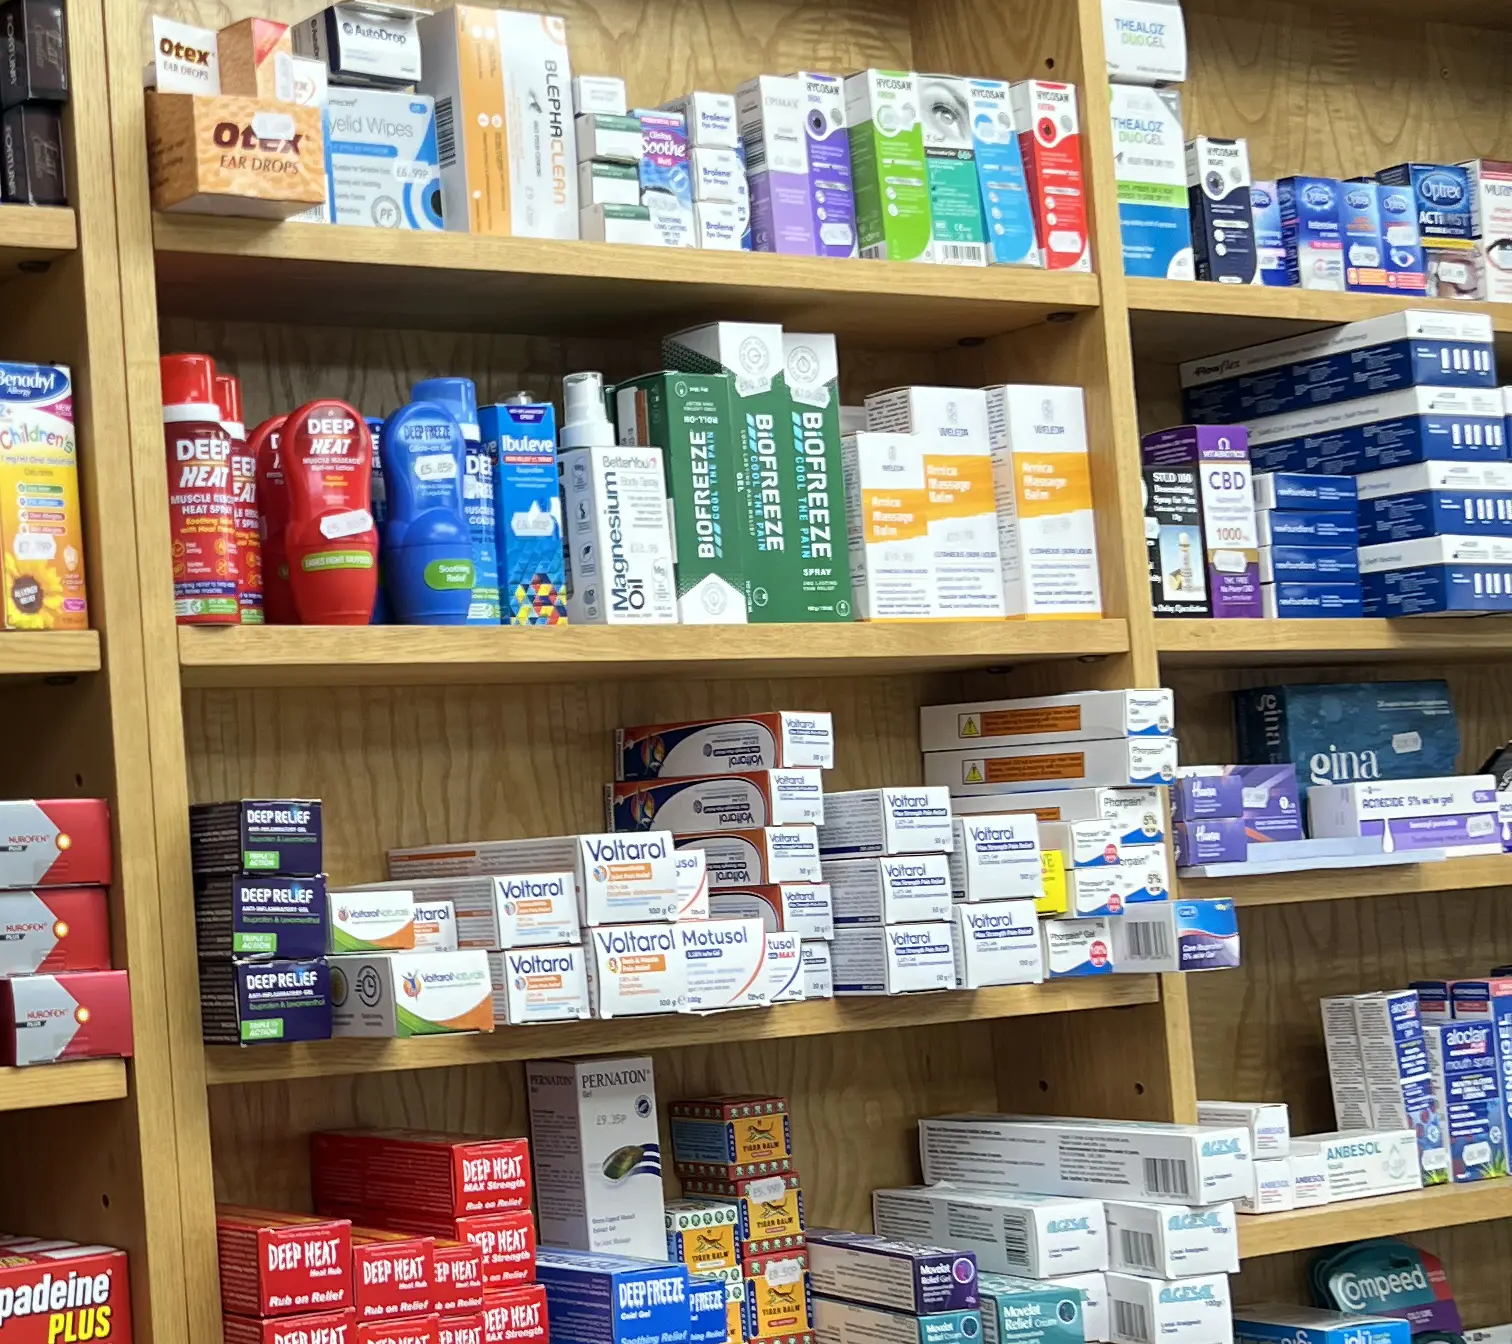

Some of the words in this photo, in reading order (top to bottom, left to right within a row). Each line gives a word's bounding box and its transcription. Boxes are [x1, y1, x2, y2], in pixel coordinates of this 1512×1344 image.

[355, 24, 407, 45] AutoDrop
[544, 59, 568, 206] BLEPHACLEAN
[219, 154, 247, 170] EAR
[250, 157, 299, 176] DROPS
[307, 418, 354, 434] DEEP
[0, 425, 74, 452] Children's
[310, 438, 352, 455] HEAT
[502, 435, 554, 453] Ibuleve
[1209, 471, 1245, 490] CBD
[609, 471, 629, 611] Magnesium
[1310, 745, 1381, 785] gina
[969, 826, 1014, 841] Voltarol
[967, 912, 1013, 928] Voltarol
[598, 928, 676, 954] Voltarol
[681, 926, 748, 946] Motusol
[510, 954, 574, 974] Voltarol
[246, 972, 277, 990] DEEP
[277, 970, 317, 987] RELIEF
[581, 1069, 646, 1089] PERNATON
[1327, 1141, 1381, 1160] ANBESOL
[1339, 1264, 1427, 1310] Compeed
[47, 1306, 112, 1344] PLUS
